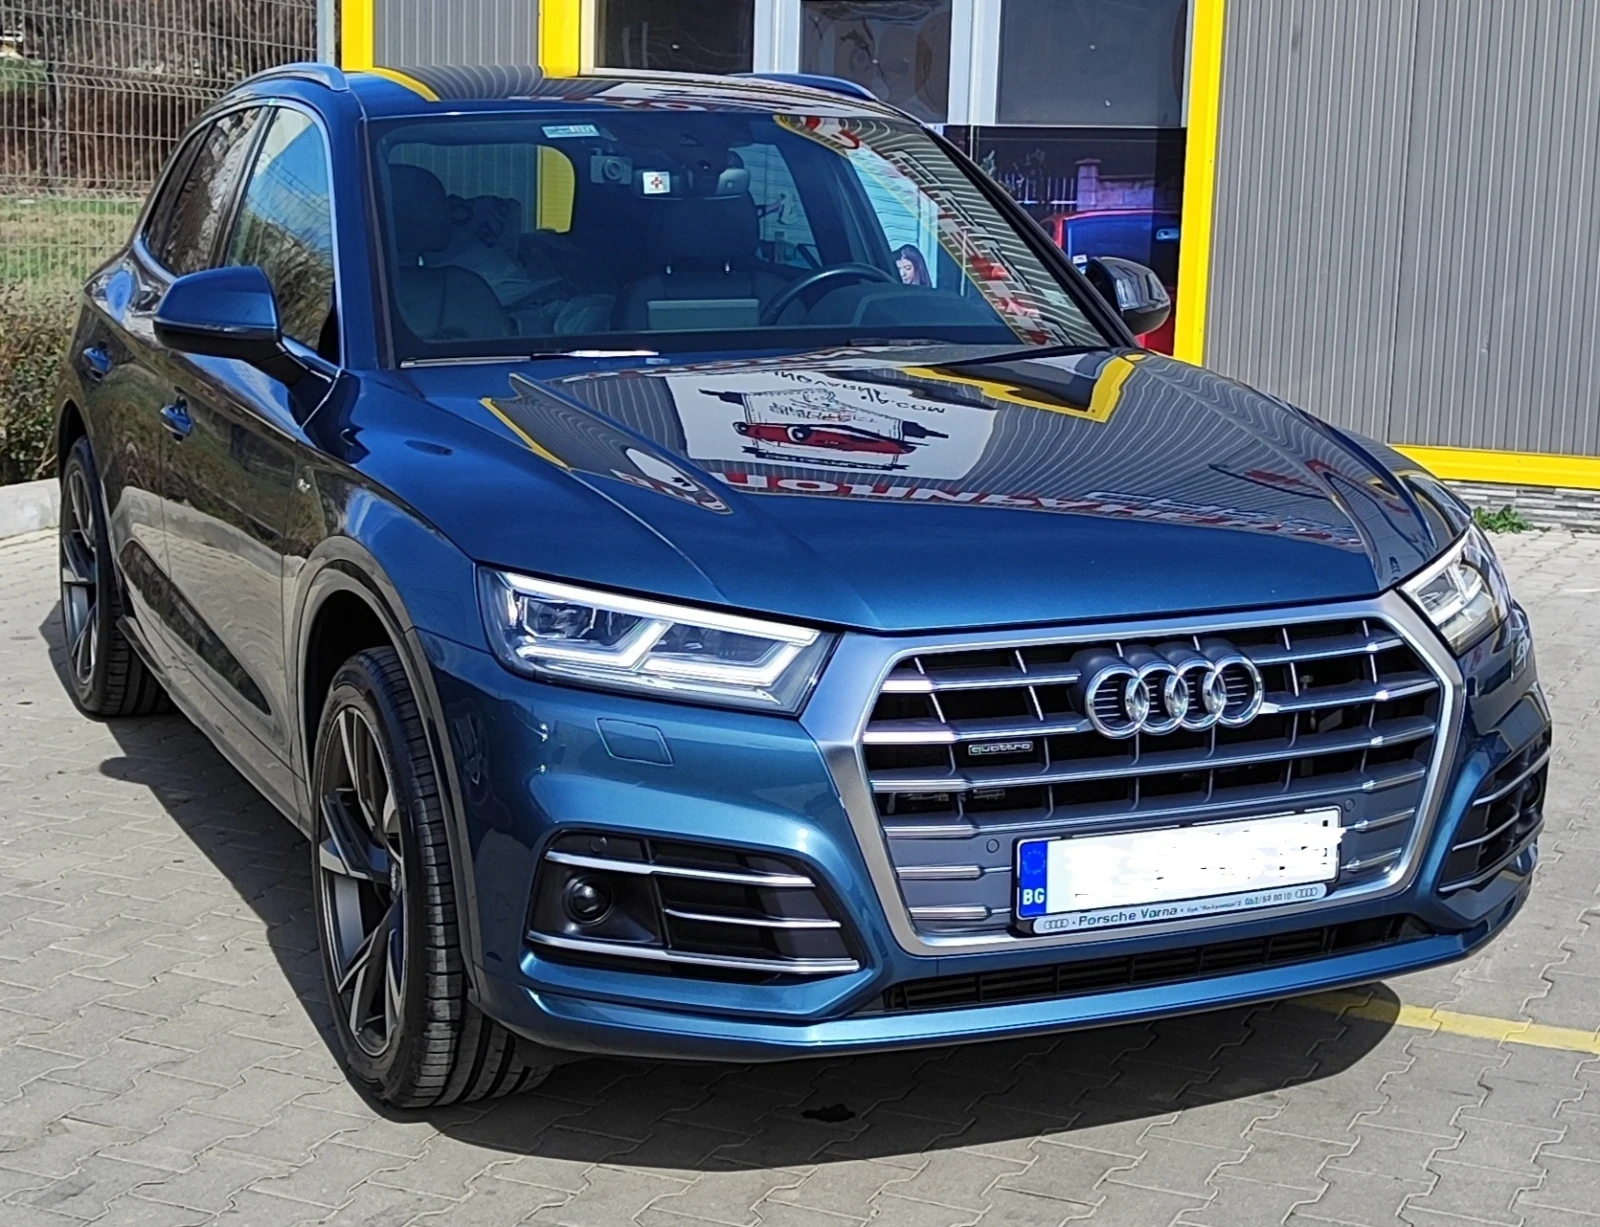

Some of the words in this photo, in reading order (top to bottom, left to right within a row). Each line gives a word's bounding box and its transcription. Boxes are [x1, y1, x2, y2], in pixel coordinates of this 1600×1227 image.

[970, 743, 1031, 754] quattro
[1022, 887, 1045, 906] BG
[1078, 912, 1137, 926] Porsche
[1141, 907, 1178, 919] Varna
